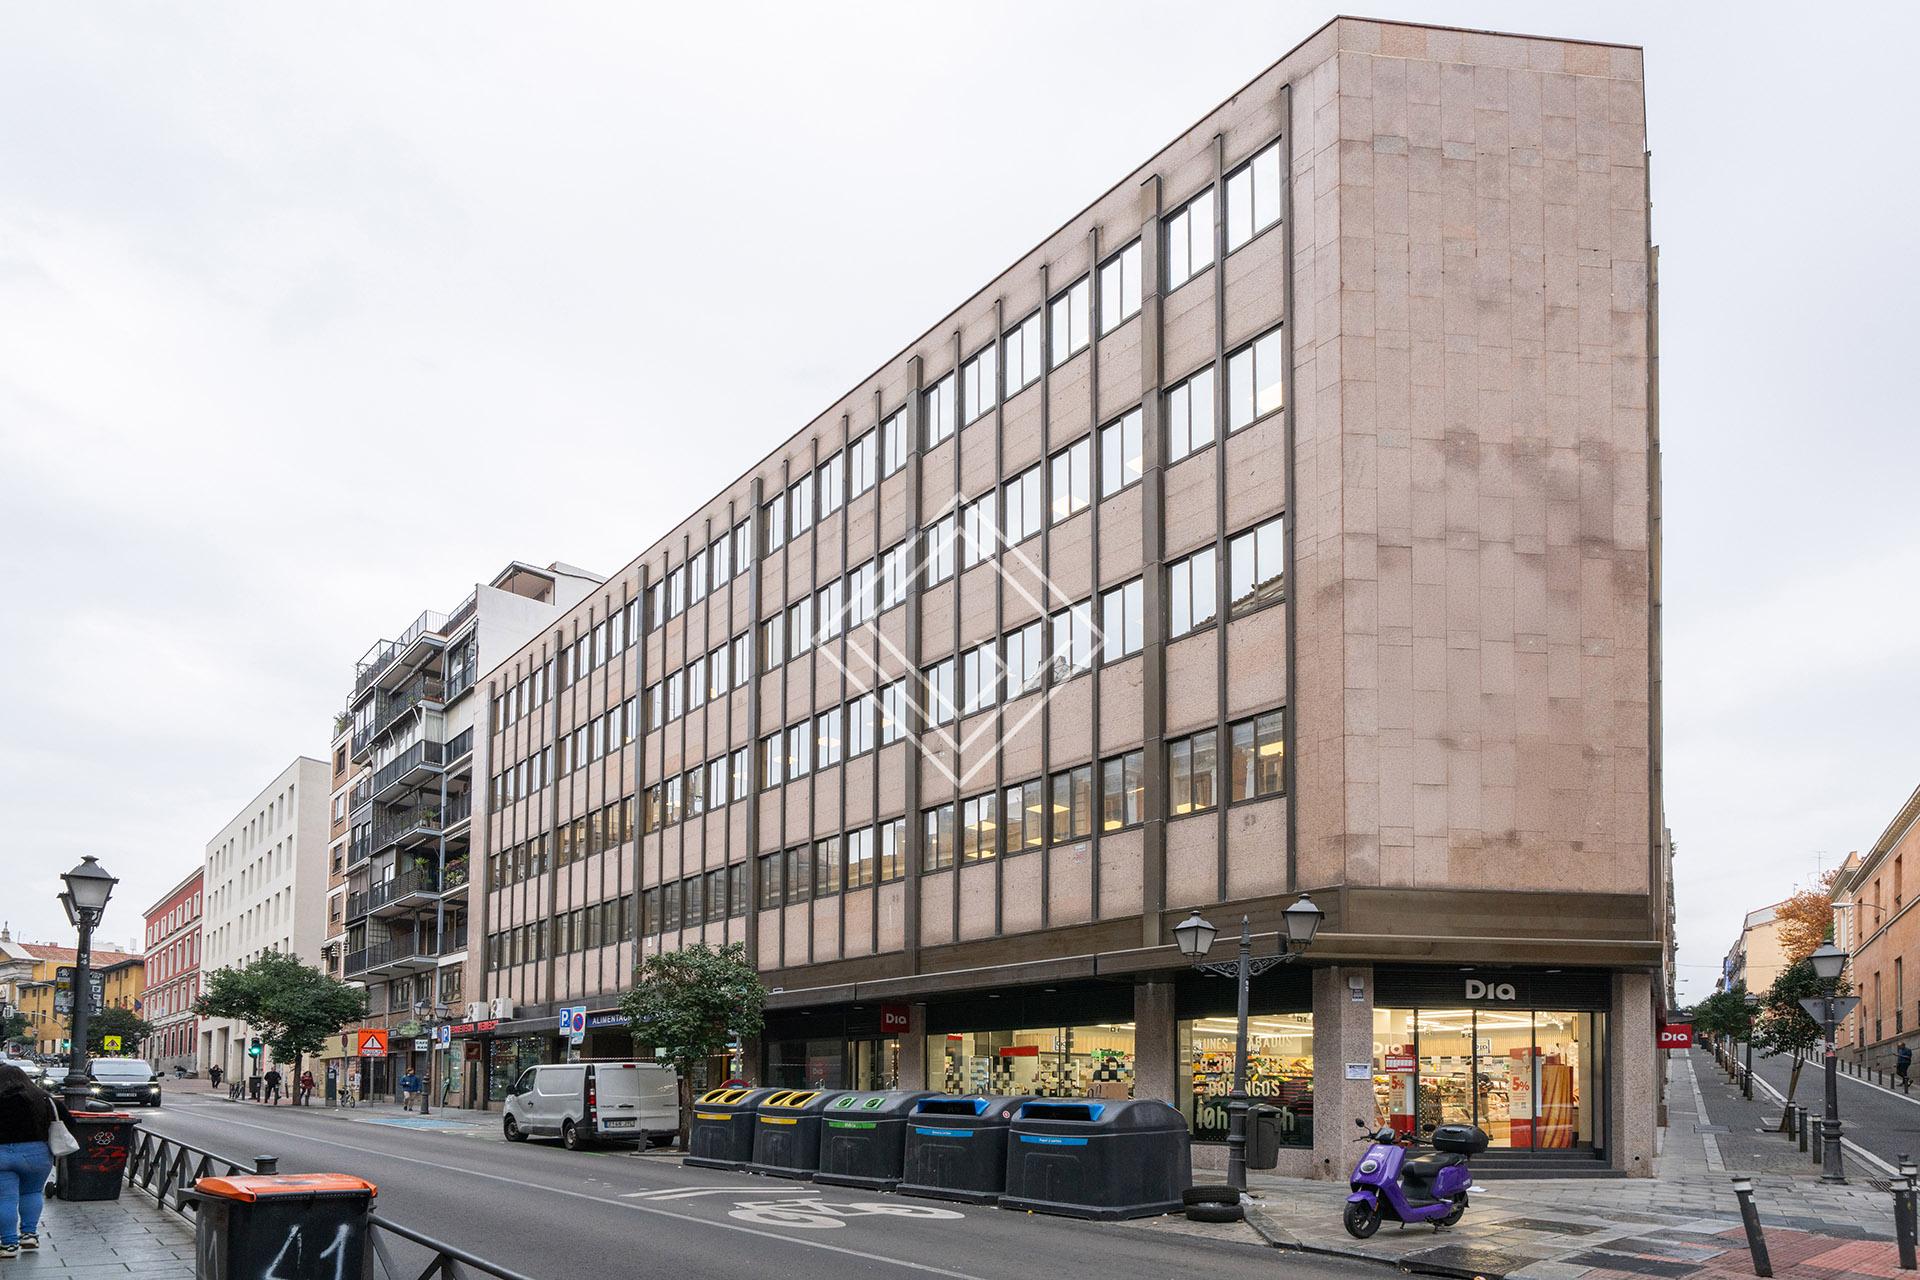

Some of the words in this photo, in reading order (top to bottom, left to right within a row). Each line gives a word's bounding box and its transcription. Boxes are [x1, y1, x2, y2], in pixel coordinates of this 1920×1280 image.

[1465, 979, 1516, 1000] Dia
[885, 1013, 907, 1025] Dia
[1661, 1032, 1688, 1041] Dia
[1512, 1077, 1530, 1091] 5%
